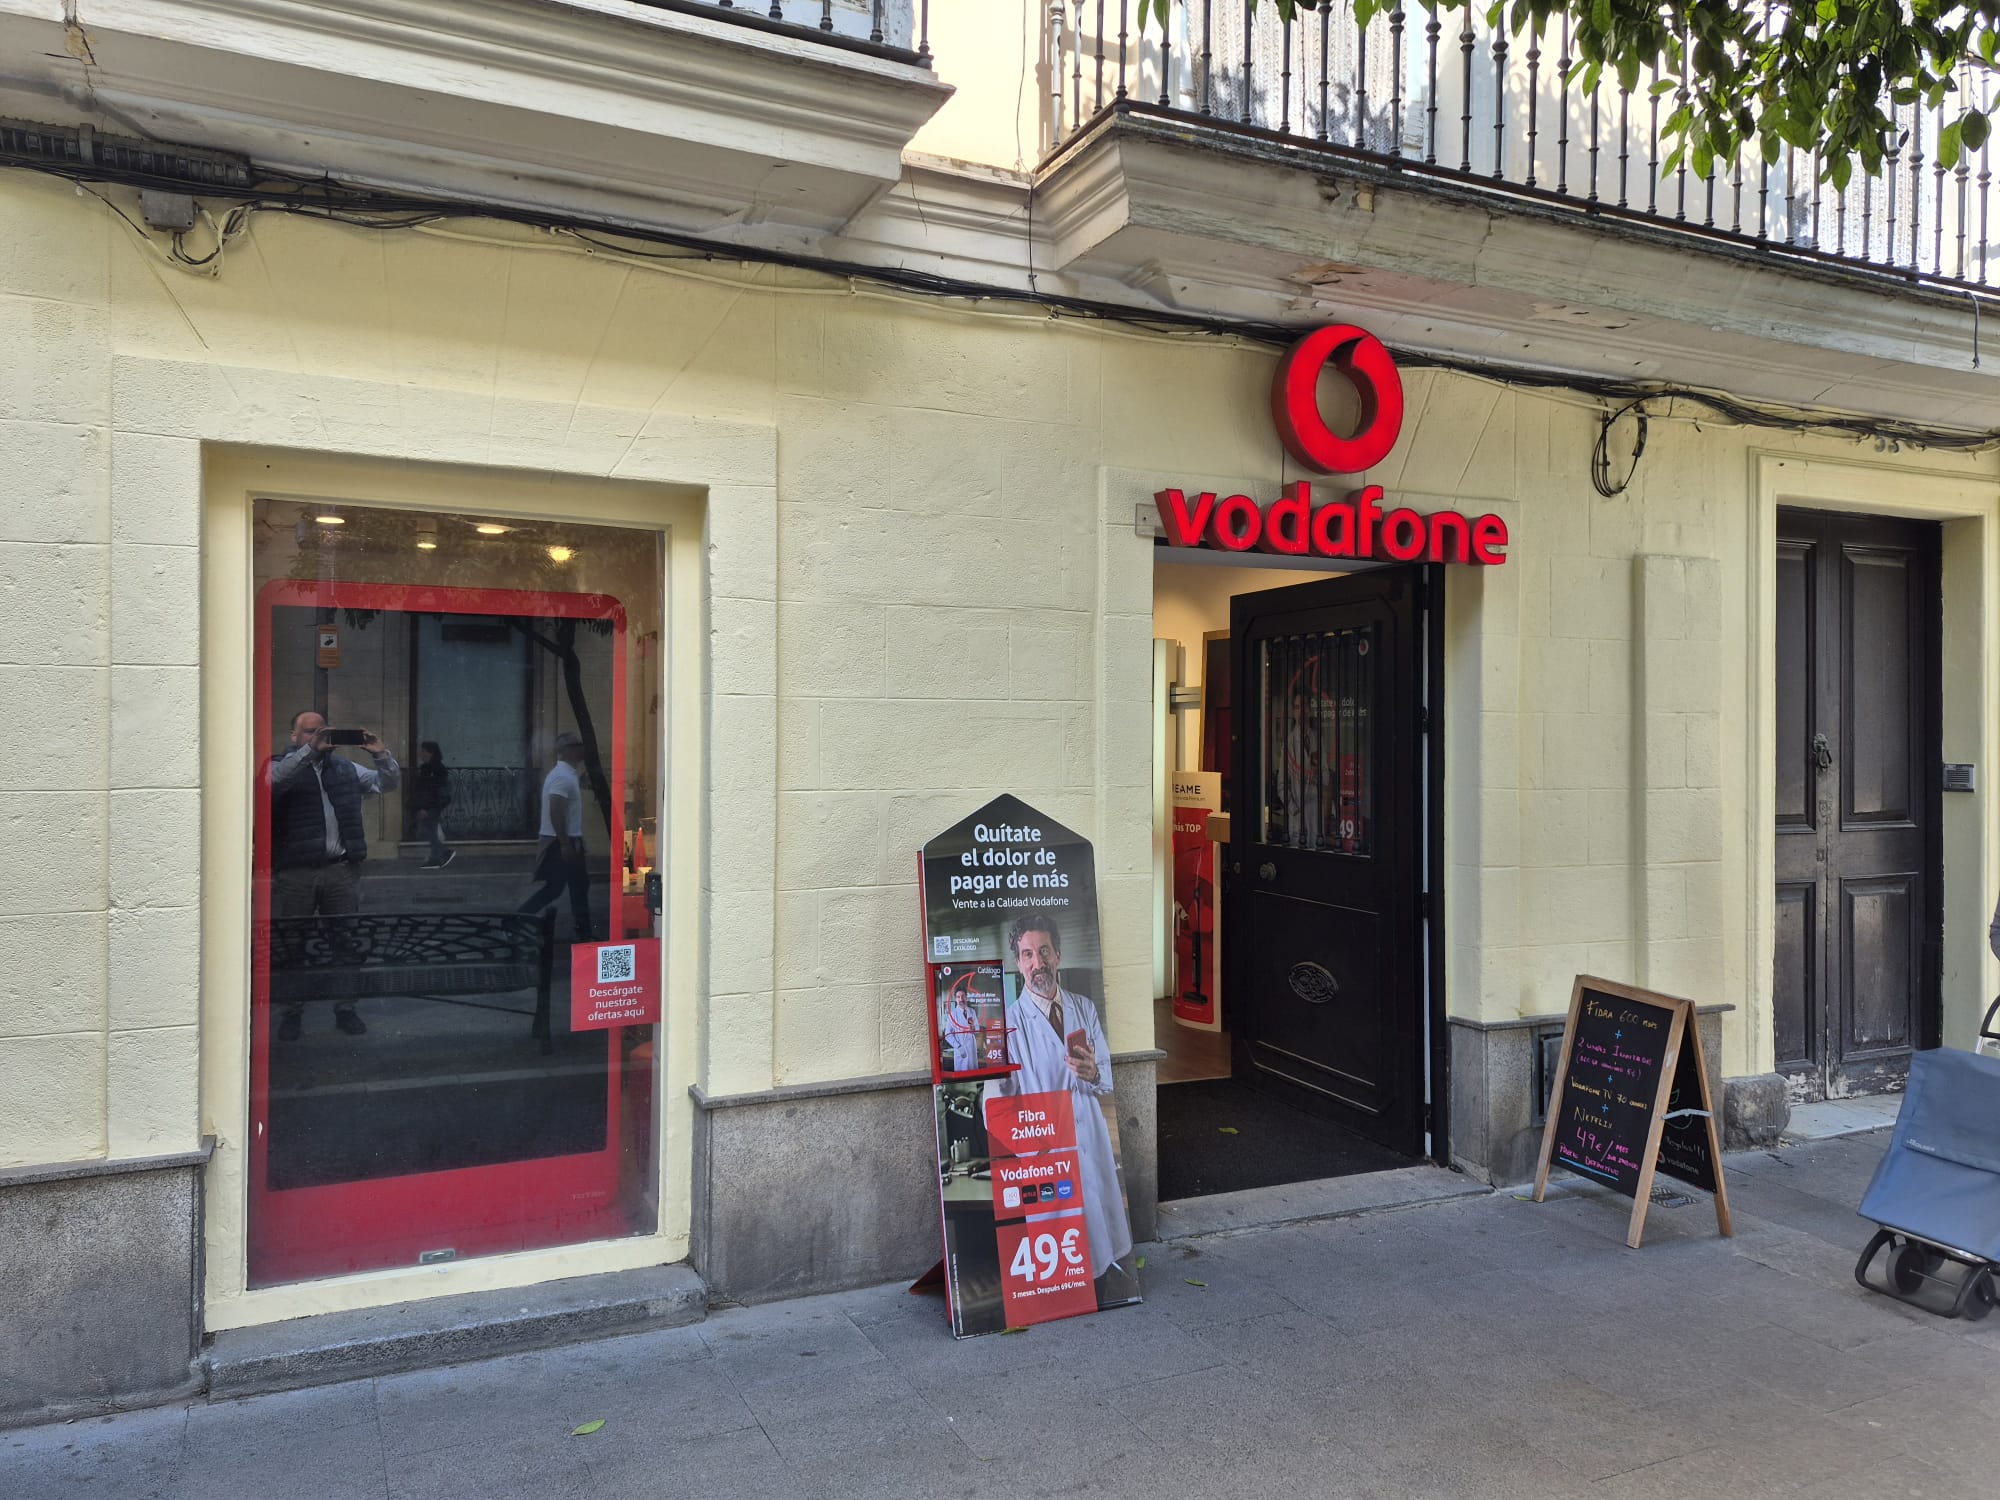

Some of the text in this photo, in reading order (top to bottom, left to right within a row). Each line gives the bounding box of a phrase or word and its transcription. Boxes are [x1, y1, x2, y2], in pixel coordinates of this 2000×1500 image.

[1154, 480, 1509, 566] vodafone
[974, 823, 1042, 843] Quítate
[1185, 823, 1202, 833] TOP
[961, 847, 1056, 867] el dolor de
[950, 868, 1069, 895] pagar de más
[952, 896, 1070, 909] Vente a la Calidad Vodafone
[977, 966, 1001, 975] Catálogo
[589, 986, 644, 998] Descárgate
[595, 998, 638, 1009] nuestras
[588, 1006, 645, 1021] ofertas aquí
[1619, 1010, 1639, 1025] 600
[1578, 1036, 1585, 1048] 2
[1018, 1109, 1046, 1123] Fibra
[1011, 1123, 1055, 1140] 2xMóvil
[1000, 1160, 1071, 1182] Vodafone TV
[1010, 1228, 1083, 1282] 49€
[1065, 1266, 1085, 1277] /mes
[1037, 1284, 1060, 1294] Después
